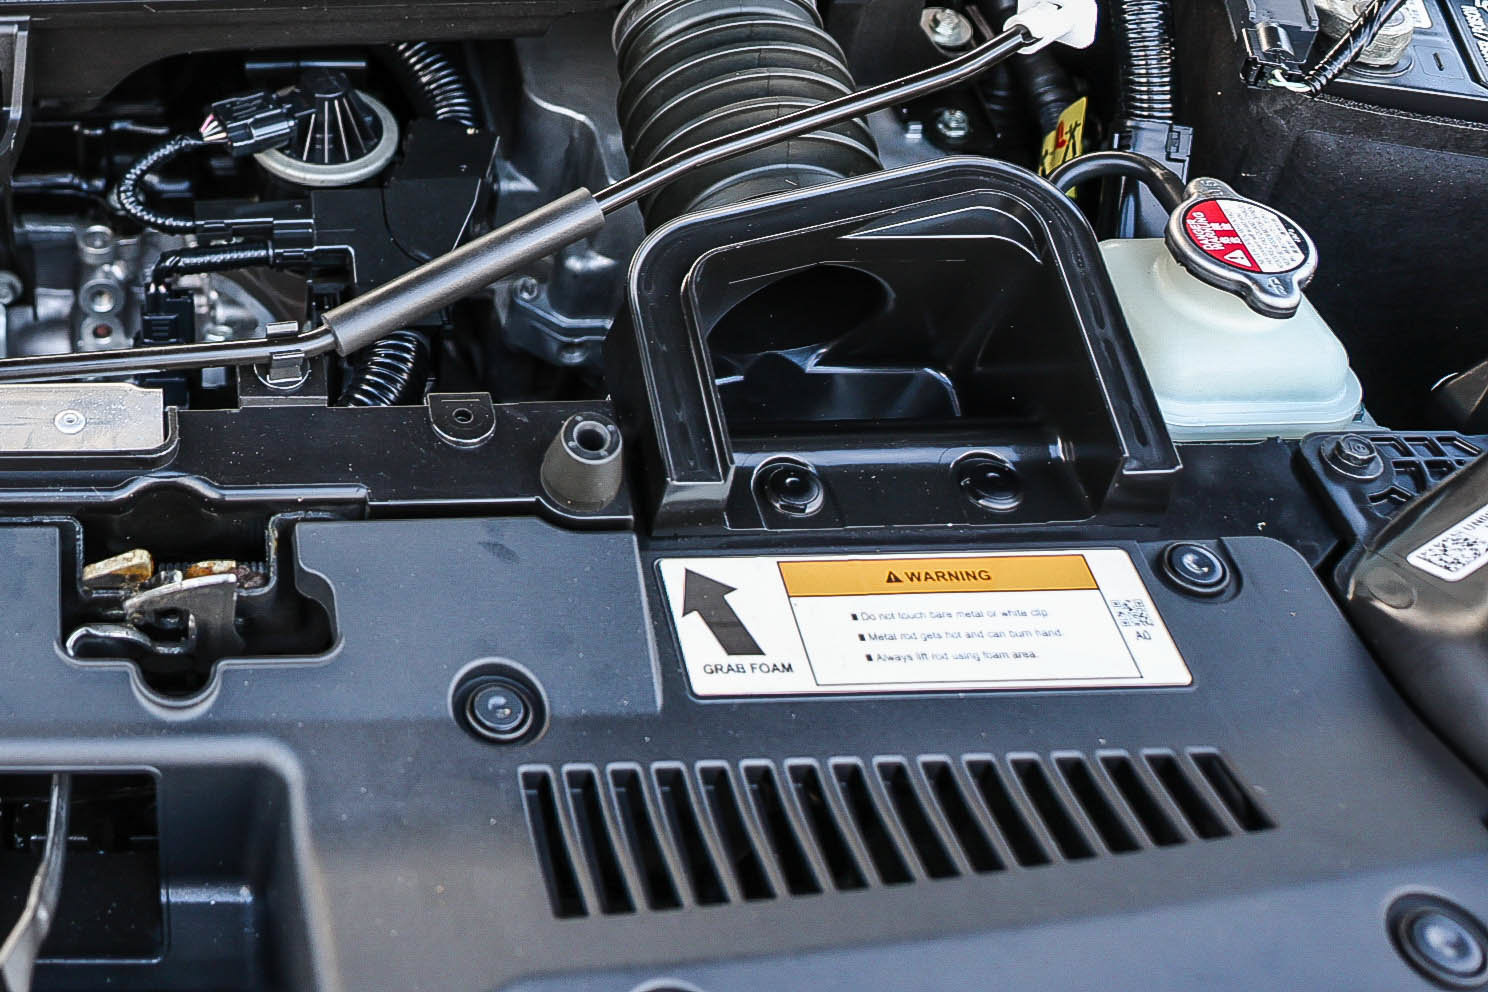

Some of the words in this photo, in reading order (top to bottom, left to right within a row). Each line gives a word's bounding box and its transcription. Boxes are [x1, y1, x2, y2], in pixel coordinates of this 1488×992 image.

[904, 569, 992, 583] WARNING
[861, 611, 876, 621] Do
[879, 611, 896, 620] not
[898, 611, 927, 620] touch
[929, 610, 953, 619] bare
[956, 609, 984, 618] metal
[986, 610, 997, 618] or
[1001, 609, 1028, 618] white
[868, 632, 897, 641] Metal
[900, 632, 918, 640] rod
[920, 632, 943, 642] gets
[945, 630, 961, 639] hot
[965, 630, 984, 639] and
[987, 630, 1006, 638] can
[1008, 629, 1033, 638] burn
[876, 653, 913, 663] Always
[917, 651, 928, 661] lift
[931, 651, 949, 660] rod
[952, 651, 981, 662] using
[983, 650, 1010, 659] foam
[703, 663, 746, 675] GRAB
[750, 662, 793, 674] FOAM
